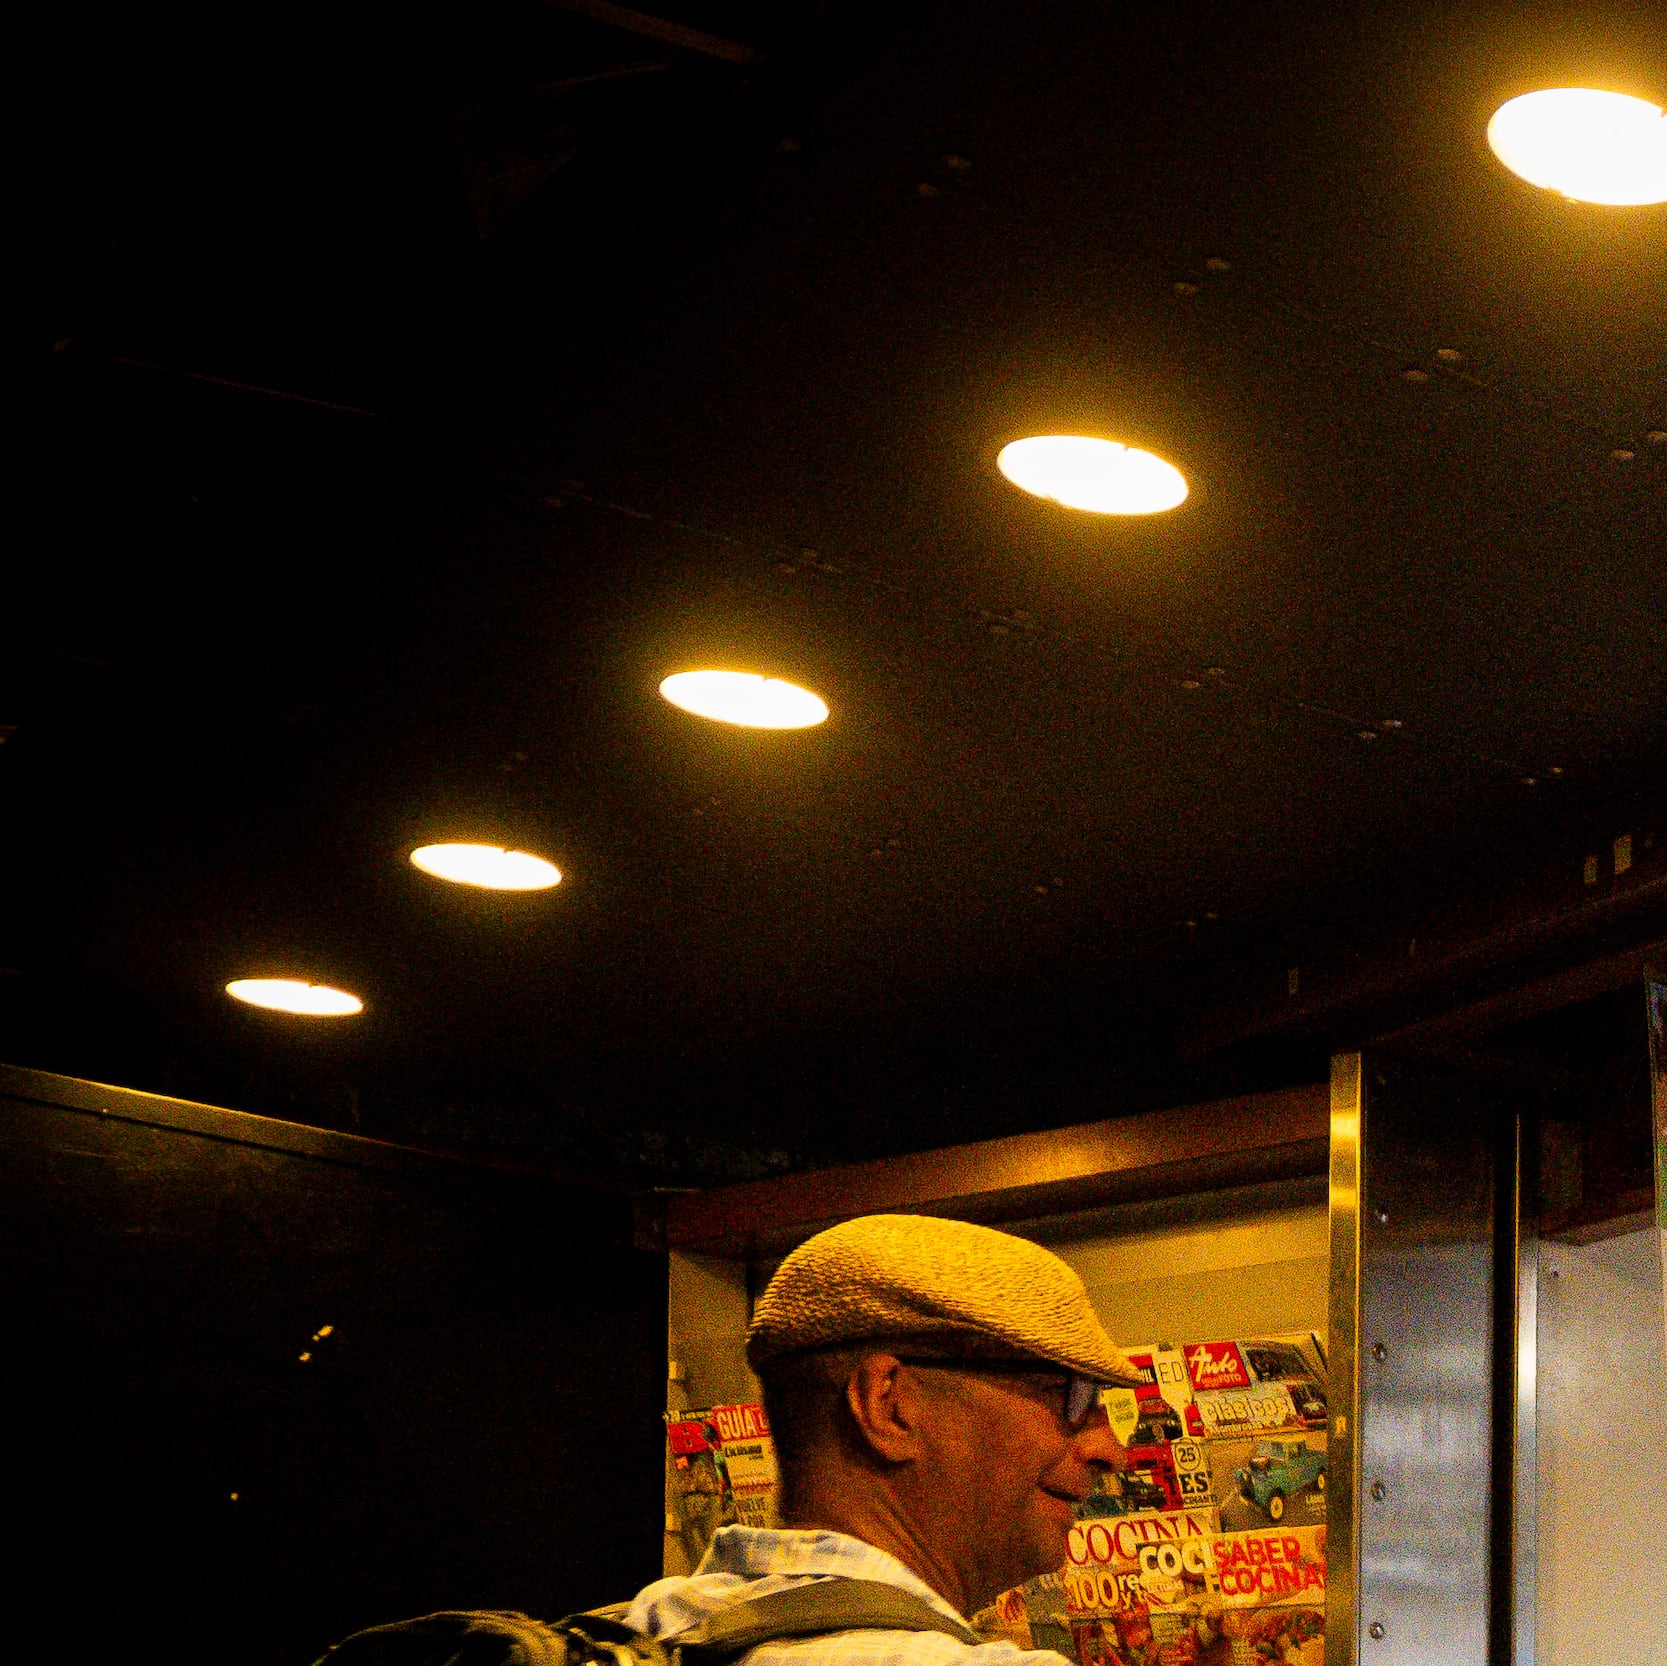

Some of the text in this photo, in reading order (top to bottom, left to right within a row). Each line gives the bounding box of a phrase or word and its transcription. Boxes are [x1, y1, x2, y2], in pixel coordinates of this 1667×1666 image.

[1176, 1446, 1199, 1465] 25
[1066, 1514, 1204, 1568] COCINA
[1213, 1537, 1301, 1571] SABER
